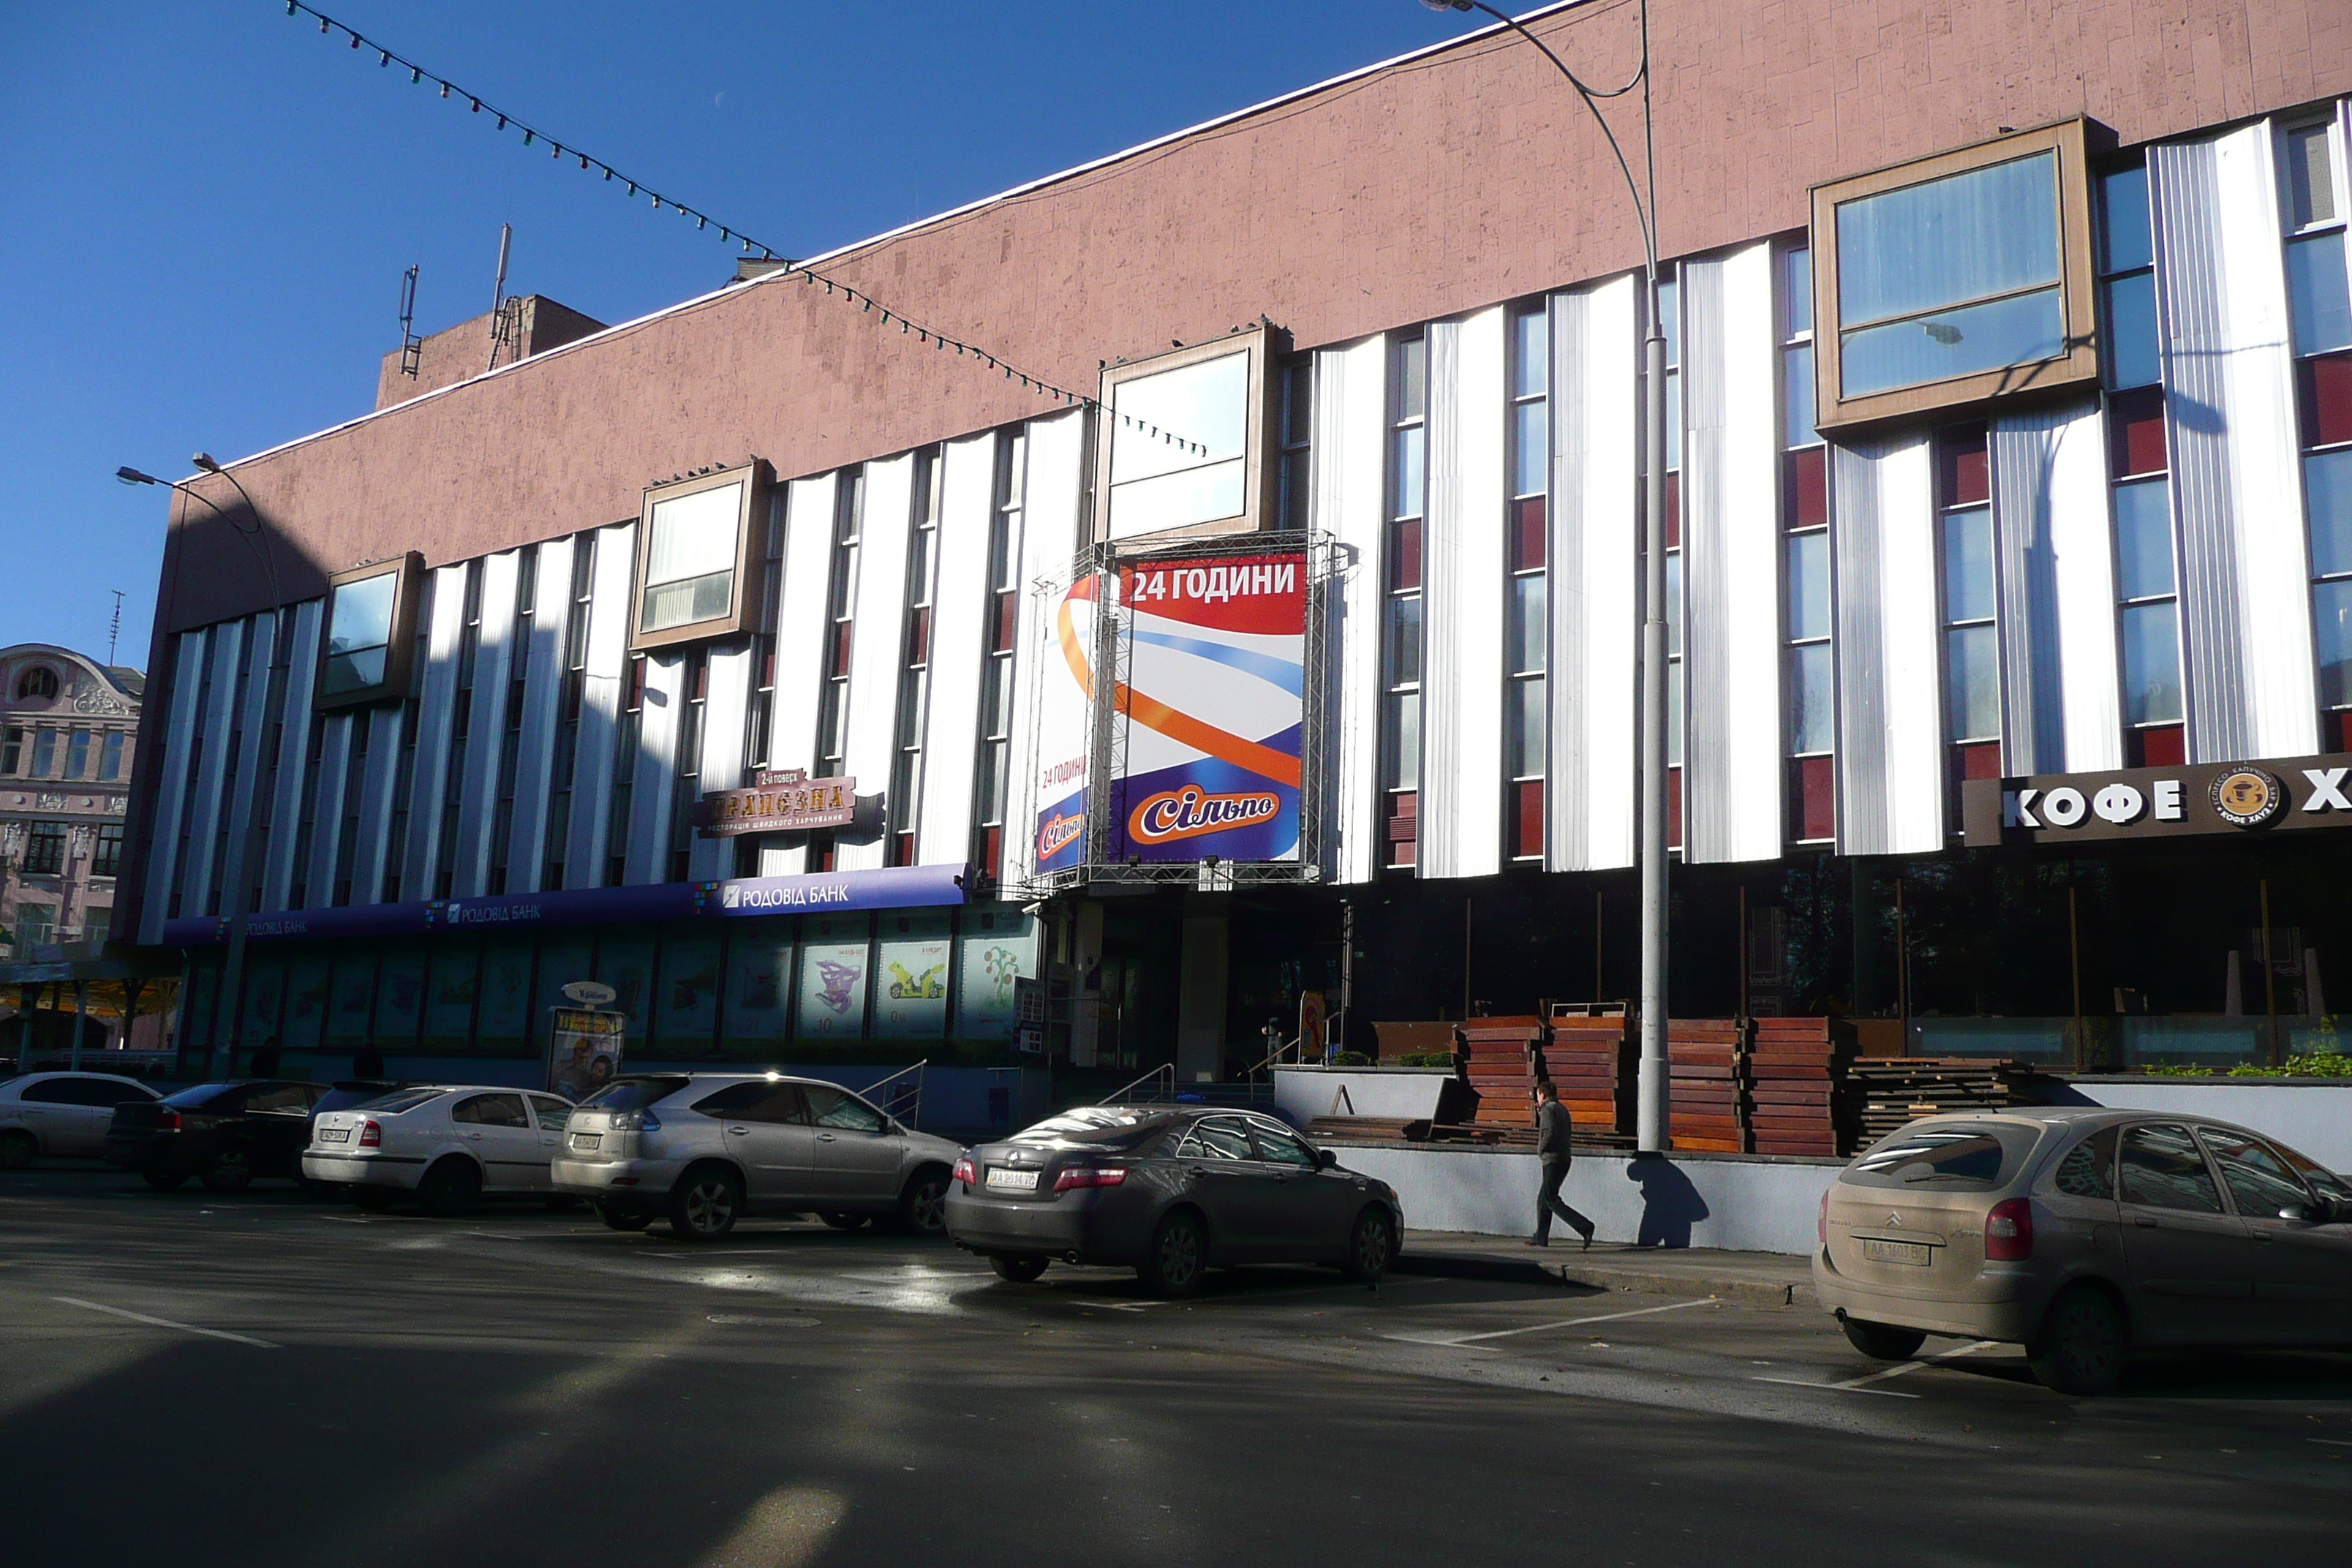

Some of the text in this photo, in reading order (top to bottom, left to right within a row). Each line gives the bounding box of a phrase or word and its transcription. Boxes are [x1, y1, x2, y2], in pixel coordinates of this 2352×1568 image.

[1131, 563, 1294, 604] 24 ГОДИНИ
[773, 772, 798, 786] поверх
[1043, 770, 1052, 789] 24
[2269, 786, 2277, 802] БАР
[2002, 779, 2181, 828] КОФЕ
[753, 818, 792, 829] ШВИДКОГО
[795, 813, 843, 825] ХАРЧУВАННЯ
[1140, 791, 1274, 837] Сільпо
[2220, 807, 2271, 823] КОФЕ ХАУЗ
[742, 883, 849, 908] РОДОВІД БАНК
[461, 904, 541, 924] РОДОВІД БАНК
[284, 919, 308, 934] БАНК
[818, 1017, 832, 1033] 10
[992, 1172, 1003, 1183] AA
[1871, 1242, 1884, 1256] AA
